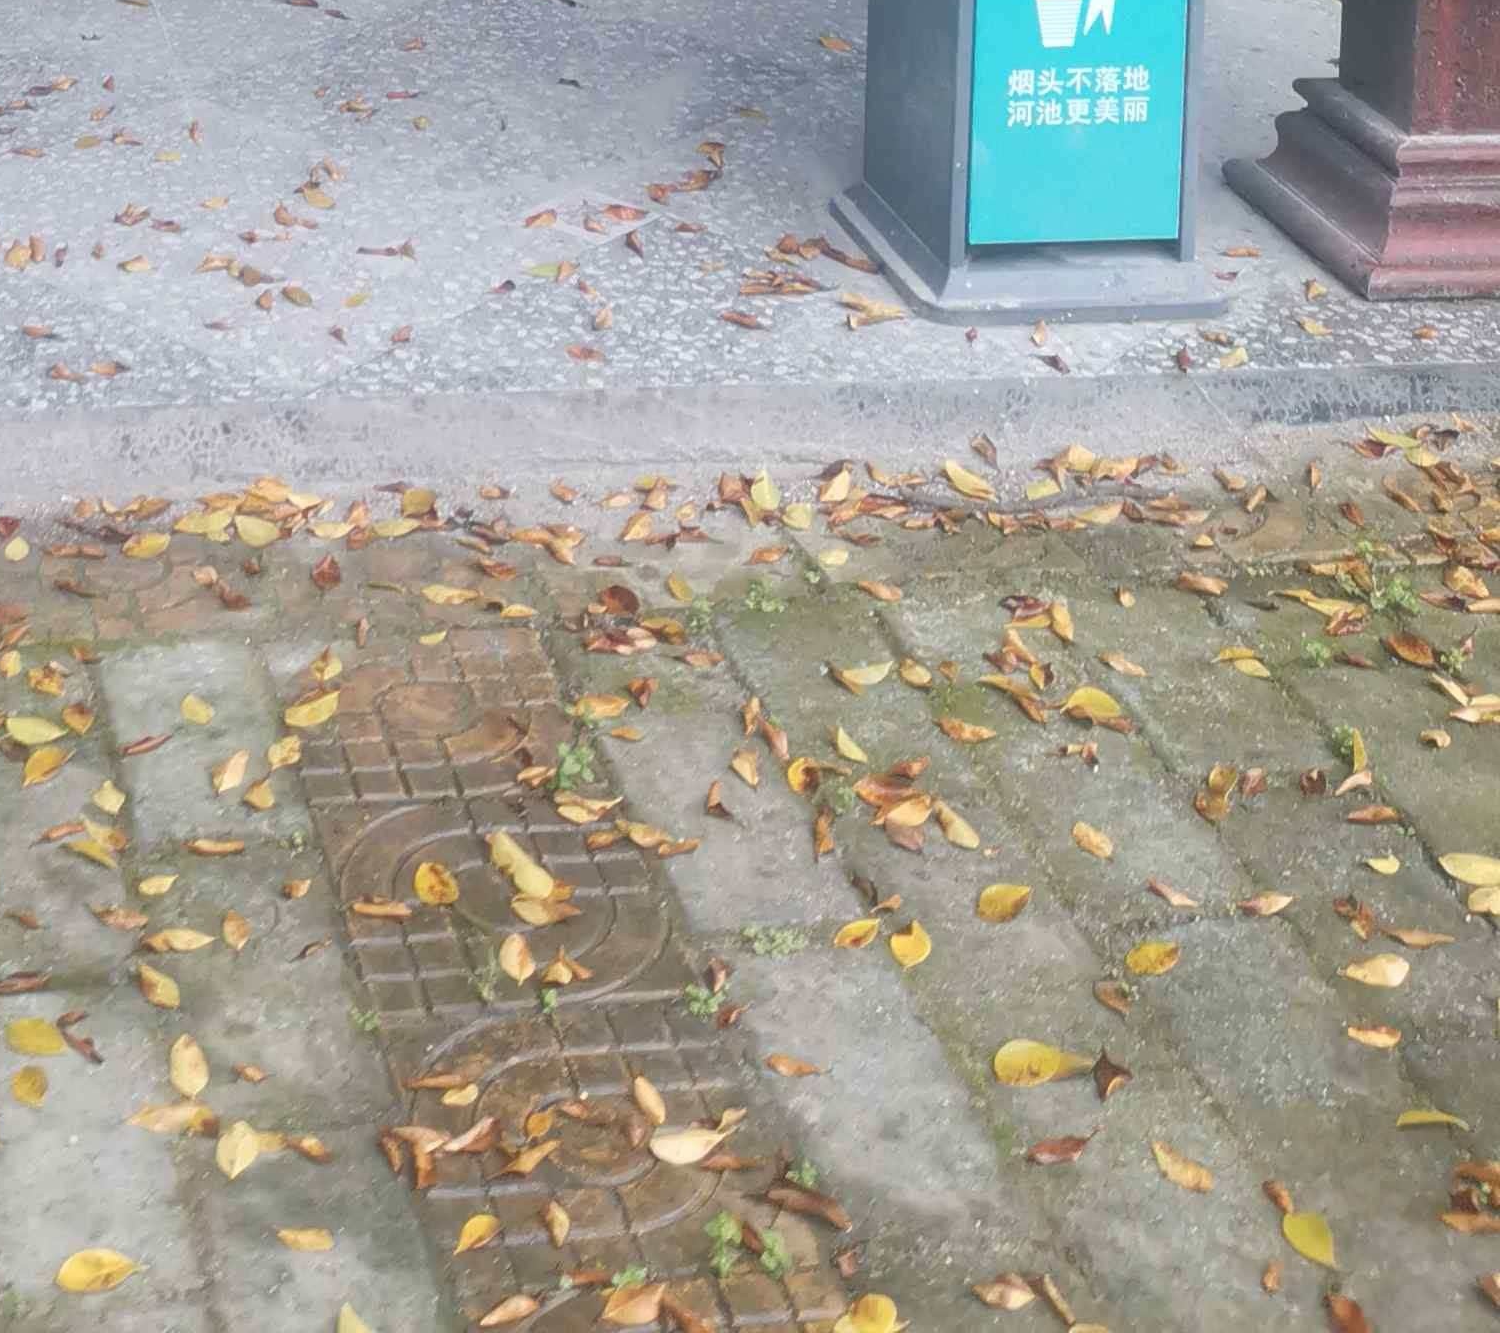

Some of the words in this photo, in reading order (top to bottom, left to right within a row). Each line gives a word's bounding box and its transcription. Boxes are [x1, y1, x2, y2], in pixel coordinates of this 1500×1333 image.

[1007, 64, 1151, 96] 烟头不落地
[1007, 96, 1151, 127] 河池更美丽
